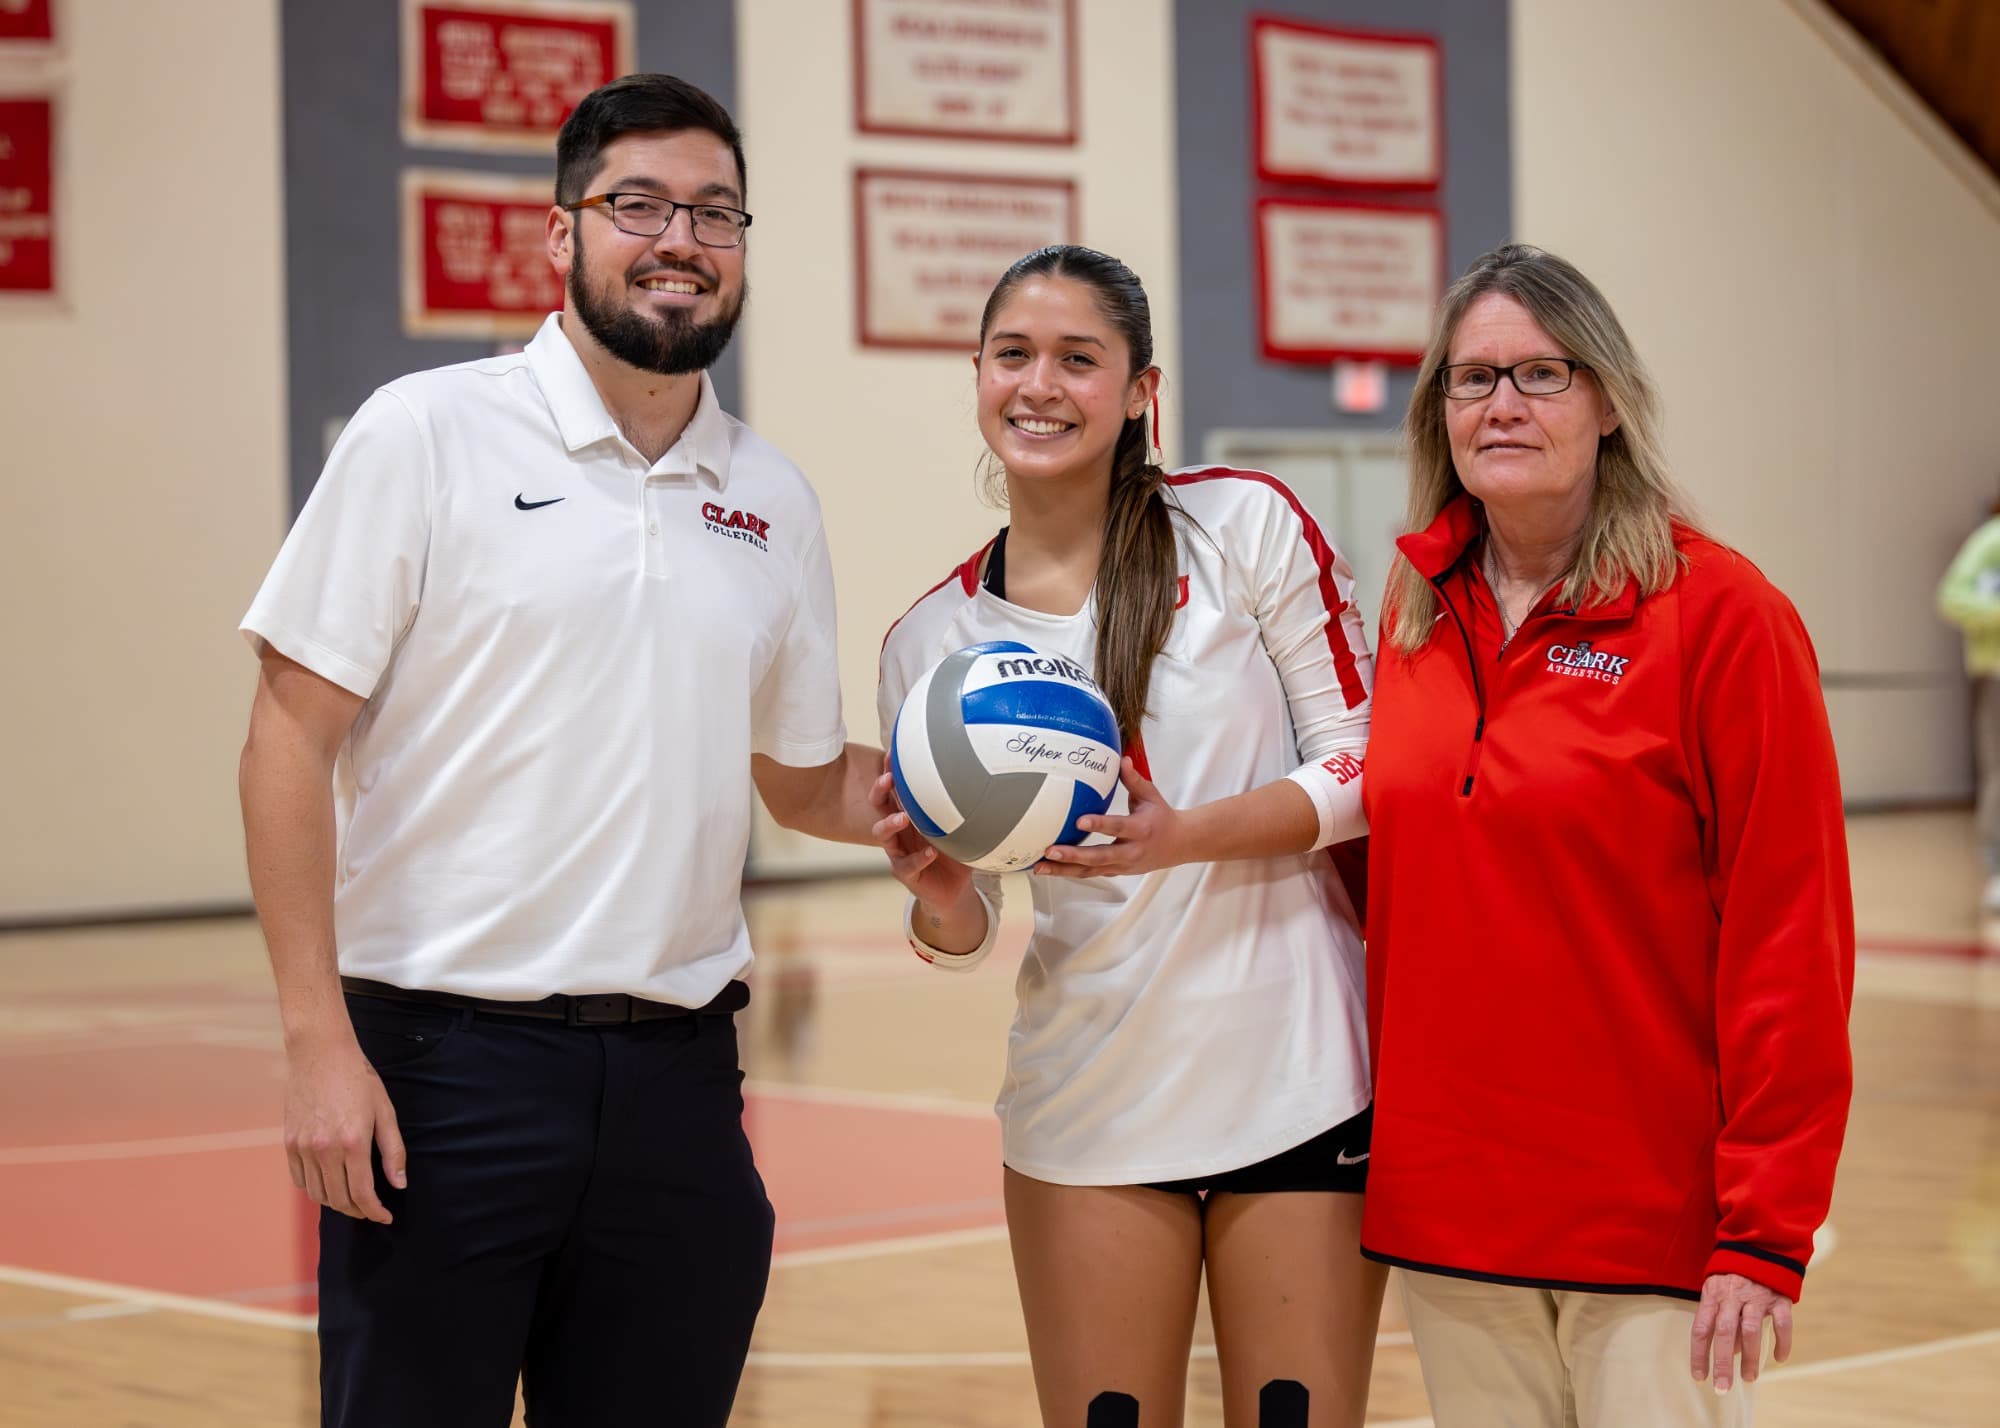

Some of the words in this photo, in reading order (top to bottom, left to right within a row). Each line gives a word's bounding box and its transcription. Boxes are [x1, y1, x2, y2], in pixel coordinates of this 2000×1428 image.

[702, 502, 770, 542] CLARK
[705, 522, 768, 552] VOLLEYBALL
[1546, 644, 1630, 676] CLARK
[1546, 662, 1620, 685] ATHLETICS
[1006, 732, 1062, 763] Super
[1067, 746, 1110, 774] Touch
